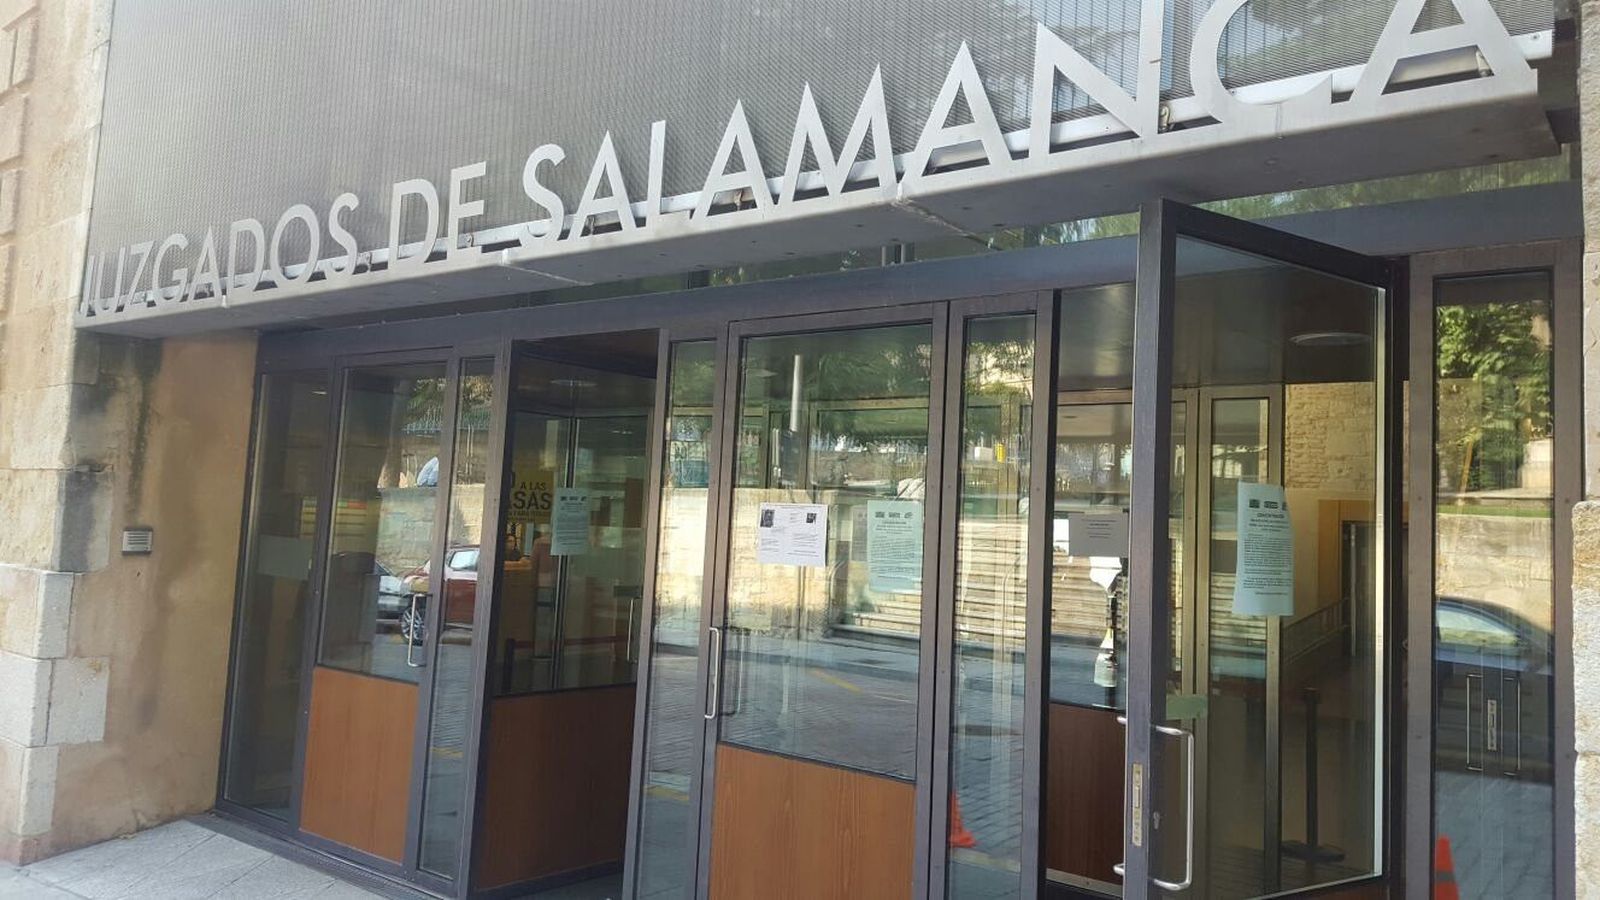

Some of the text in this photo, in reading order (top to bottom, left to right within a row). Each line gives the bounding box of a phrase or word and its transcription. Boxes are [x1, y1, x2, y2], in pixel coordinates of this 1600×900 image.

[80, 0, 1535, 315] JUZGADOS DE SALAMANCA
